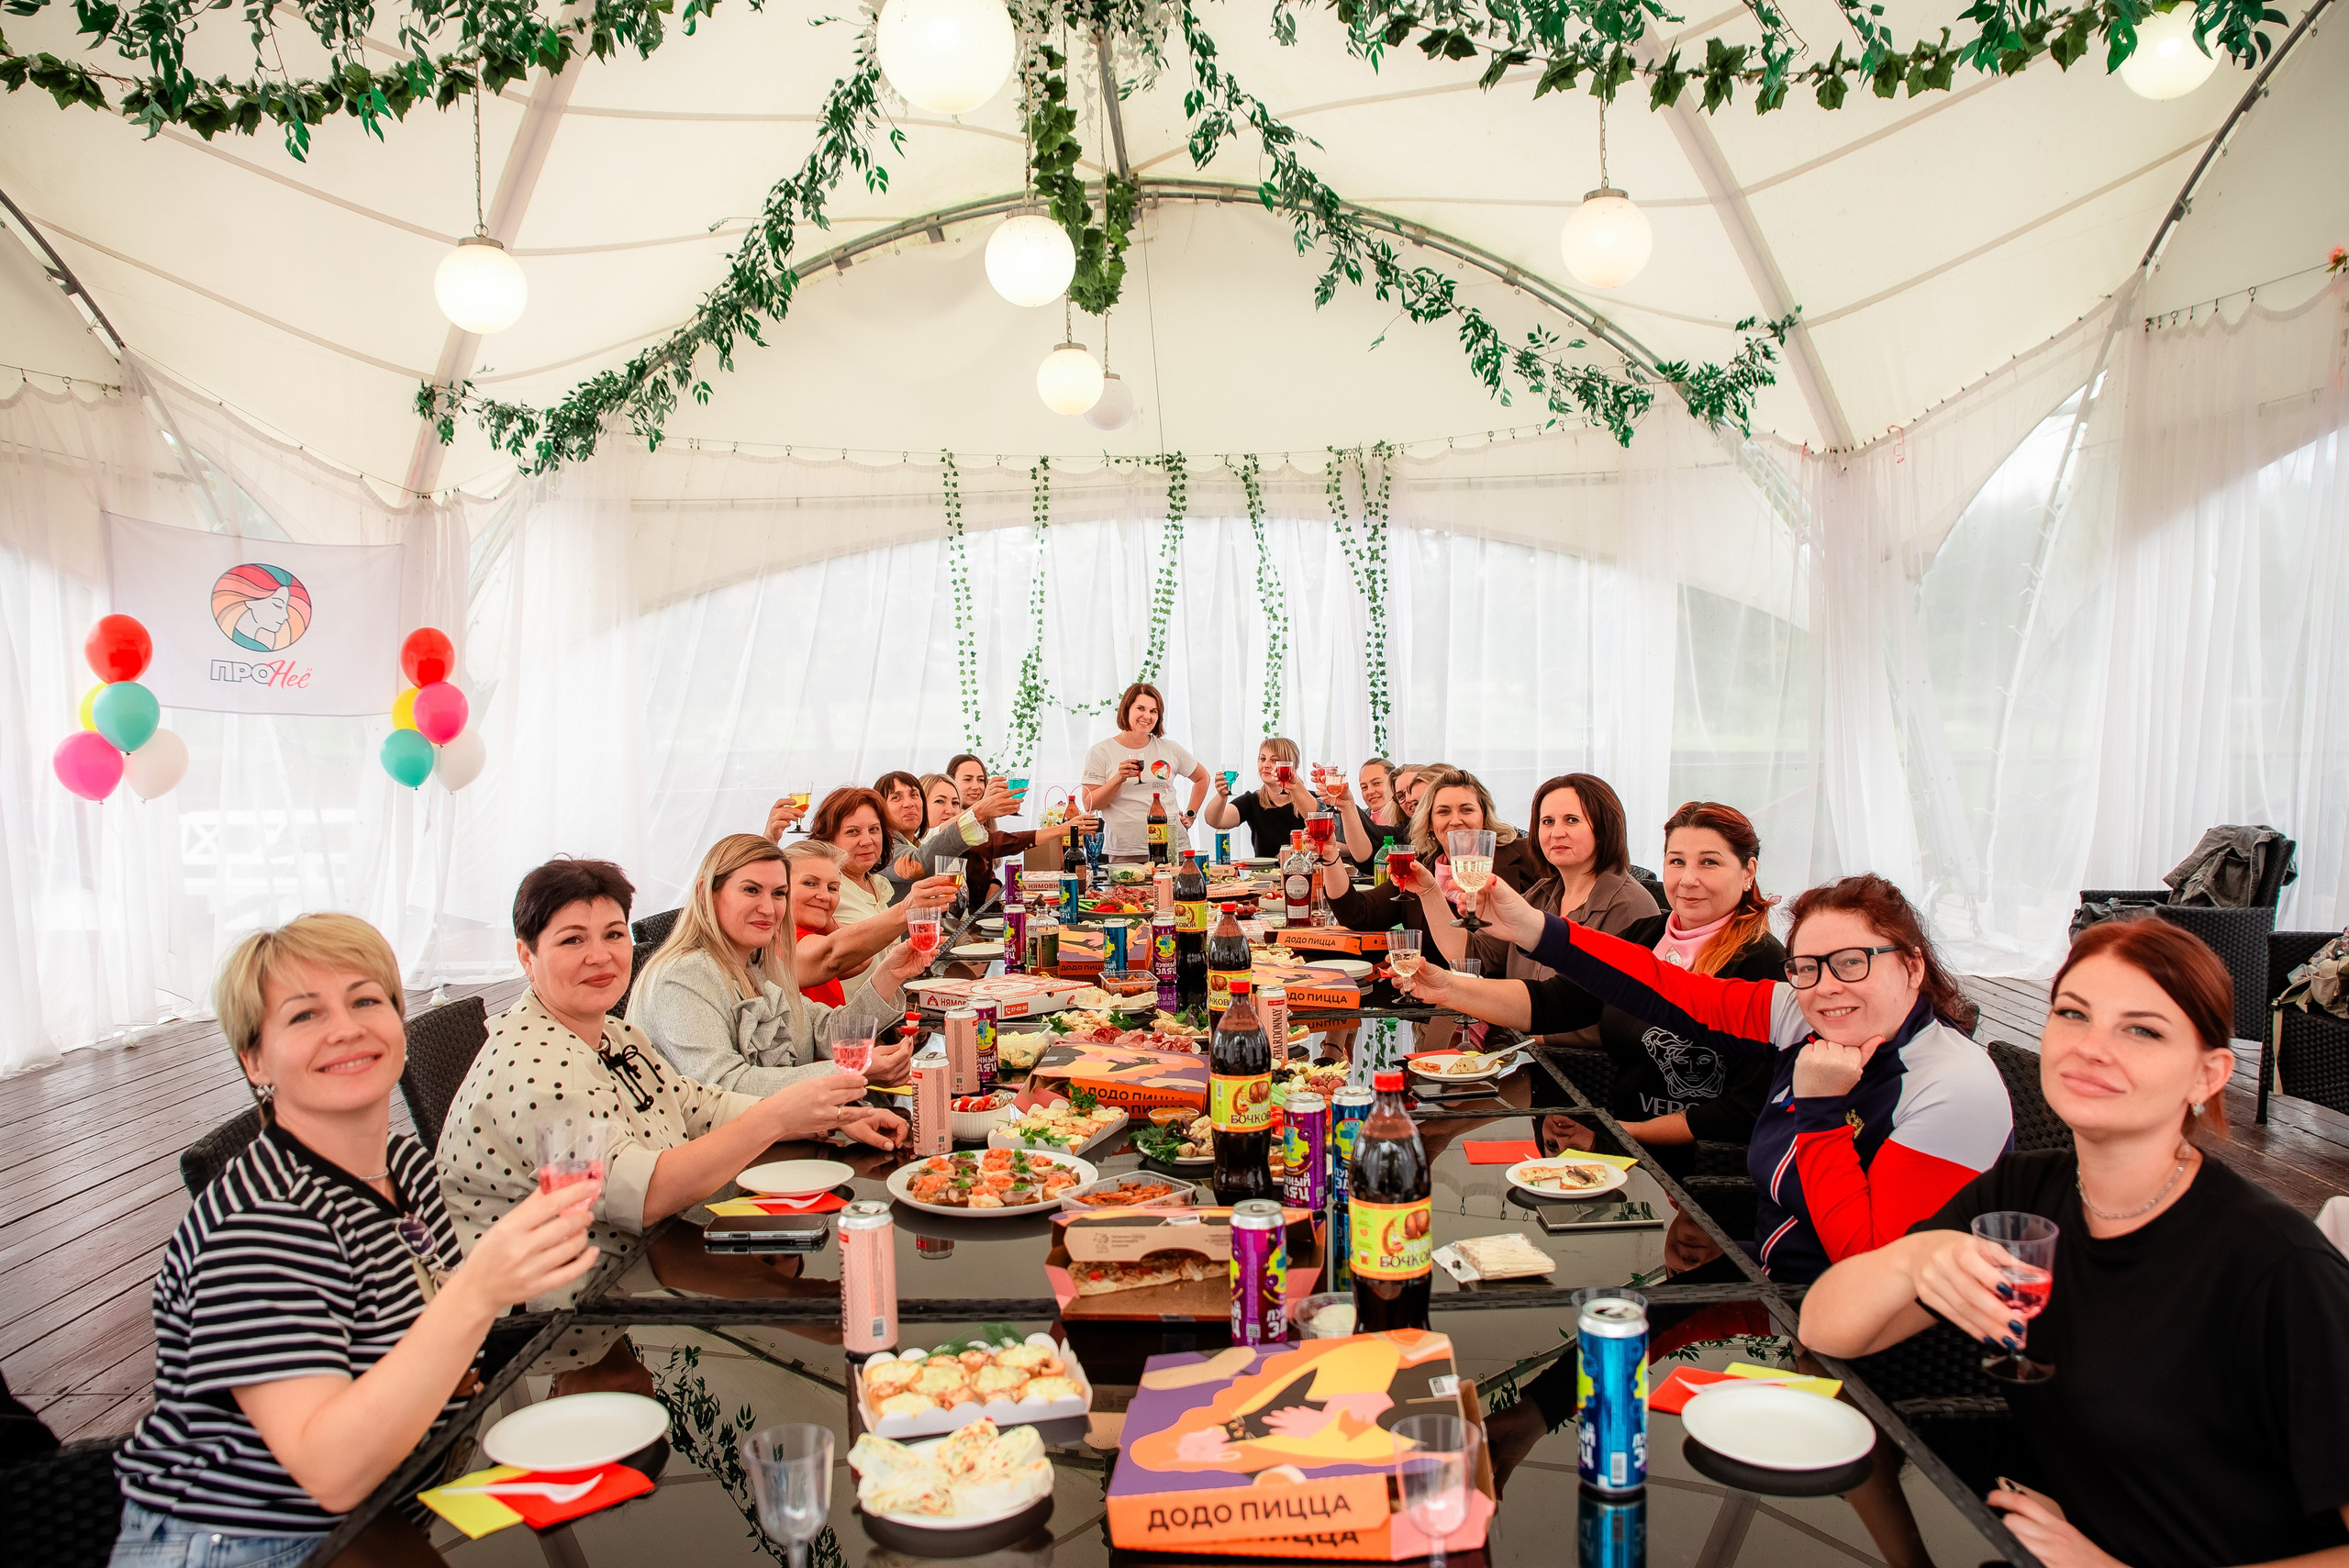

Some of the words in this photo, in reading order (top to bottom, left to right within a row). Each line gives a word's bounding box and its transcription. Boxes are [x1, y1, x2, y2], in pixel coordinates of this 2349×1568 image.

[1285, 936, 1307, 944] ДОДО
[1308, 938, 1336, 947] ПИЦЦА
[1308, 994, 1348, 1004] ПИЦЦА
[1272, 1008, 1283, 1060] CHARDONNAY
[1148, 1505, 1232, 1532] ДОДО
[1241, 1495, 1351, 1520] ПИЦЦА
